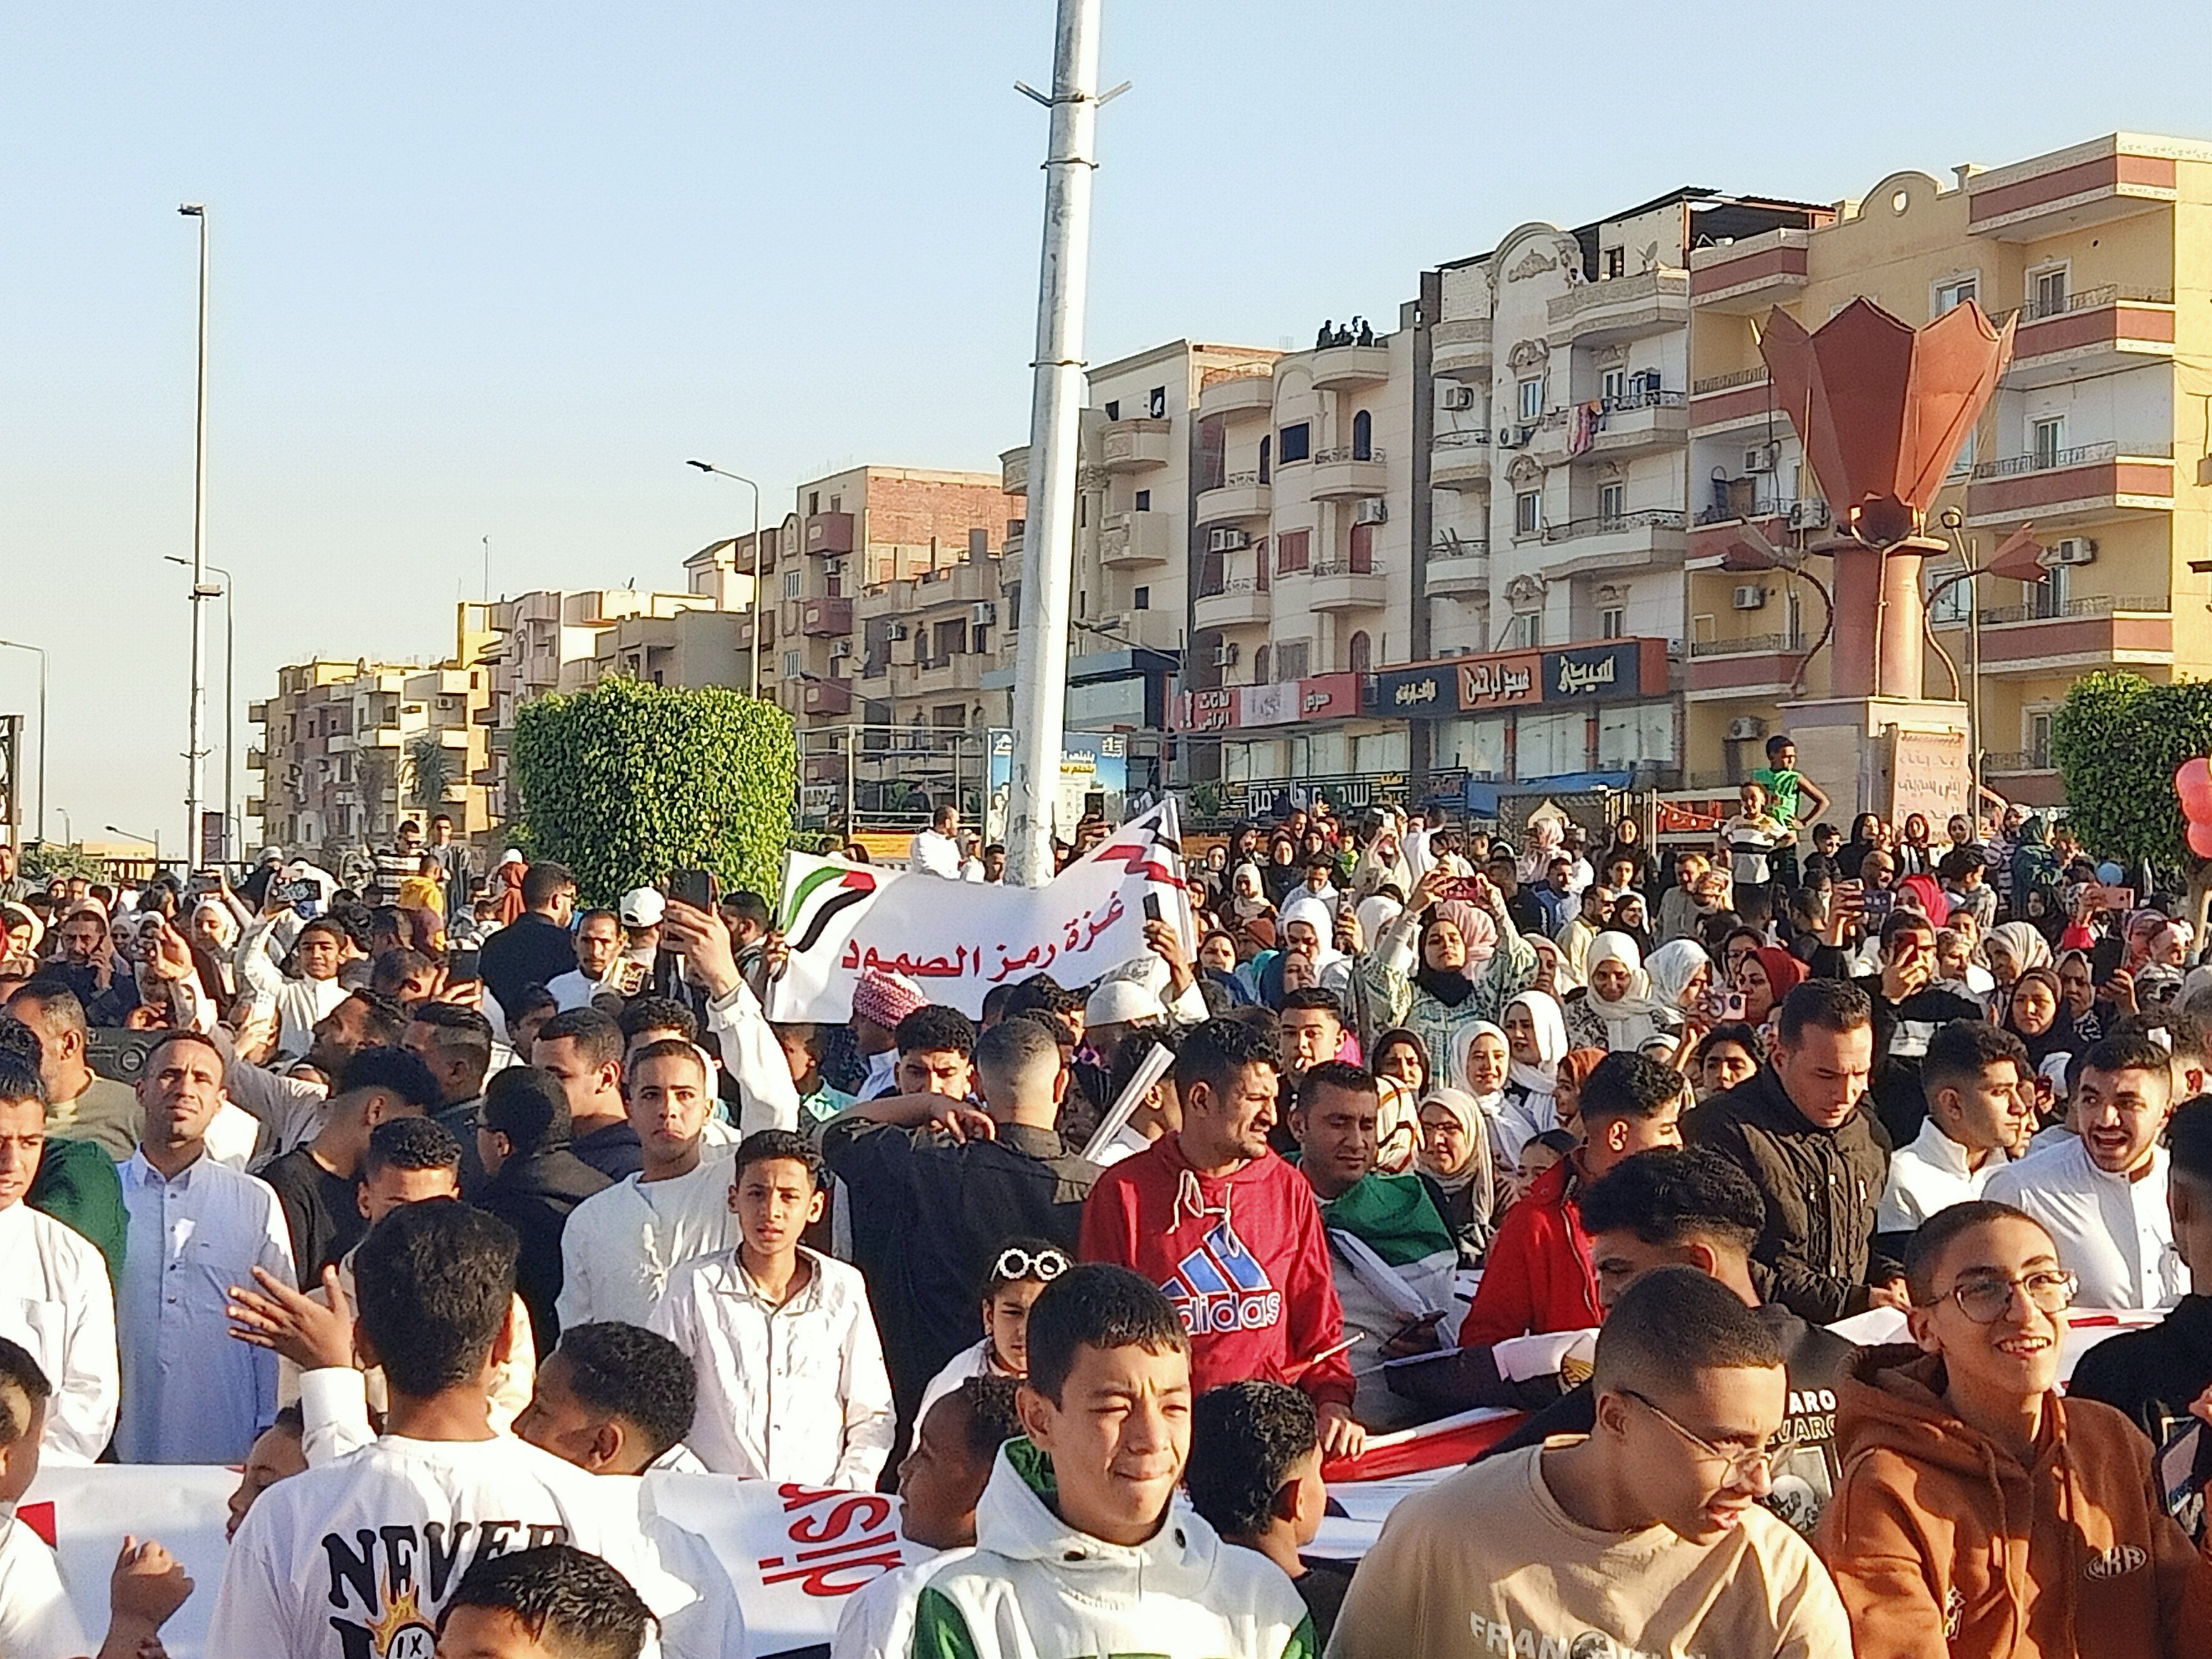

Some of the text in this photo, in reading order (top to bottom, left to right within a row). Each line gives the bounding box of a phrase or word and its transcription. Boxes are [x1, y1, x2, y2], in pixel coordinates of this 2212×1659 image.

[842, 890, 1125, 982] غزة رمز الصمود
[1177, 1292, 1281, 1337] didas
